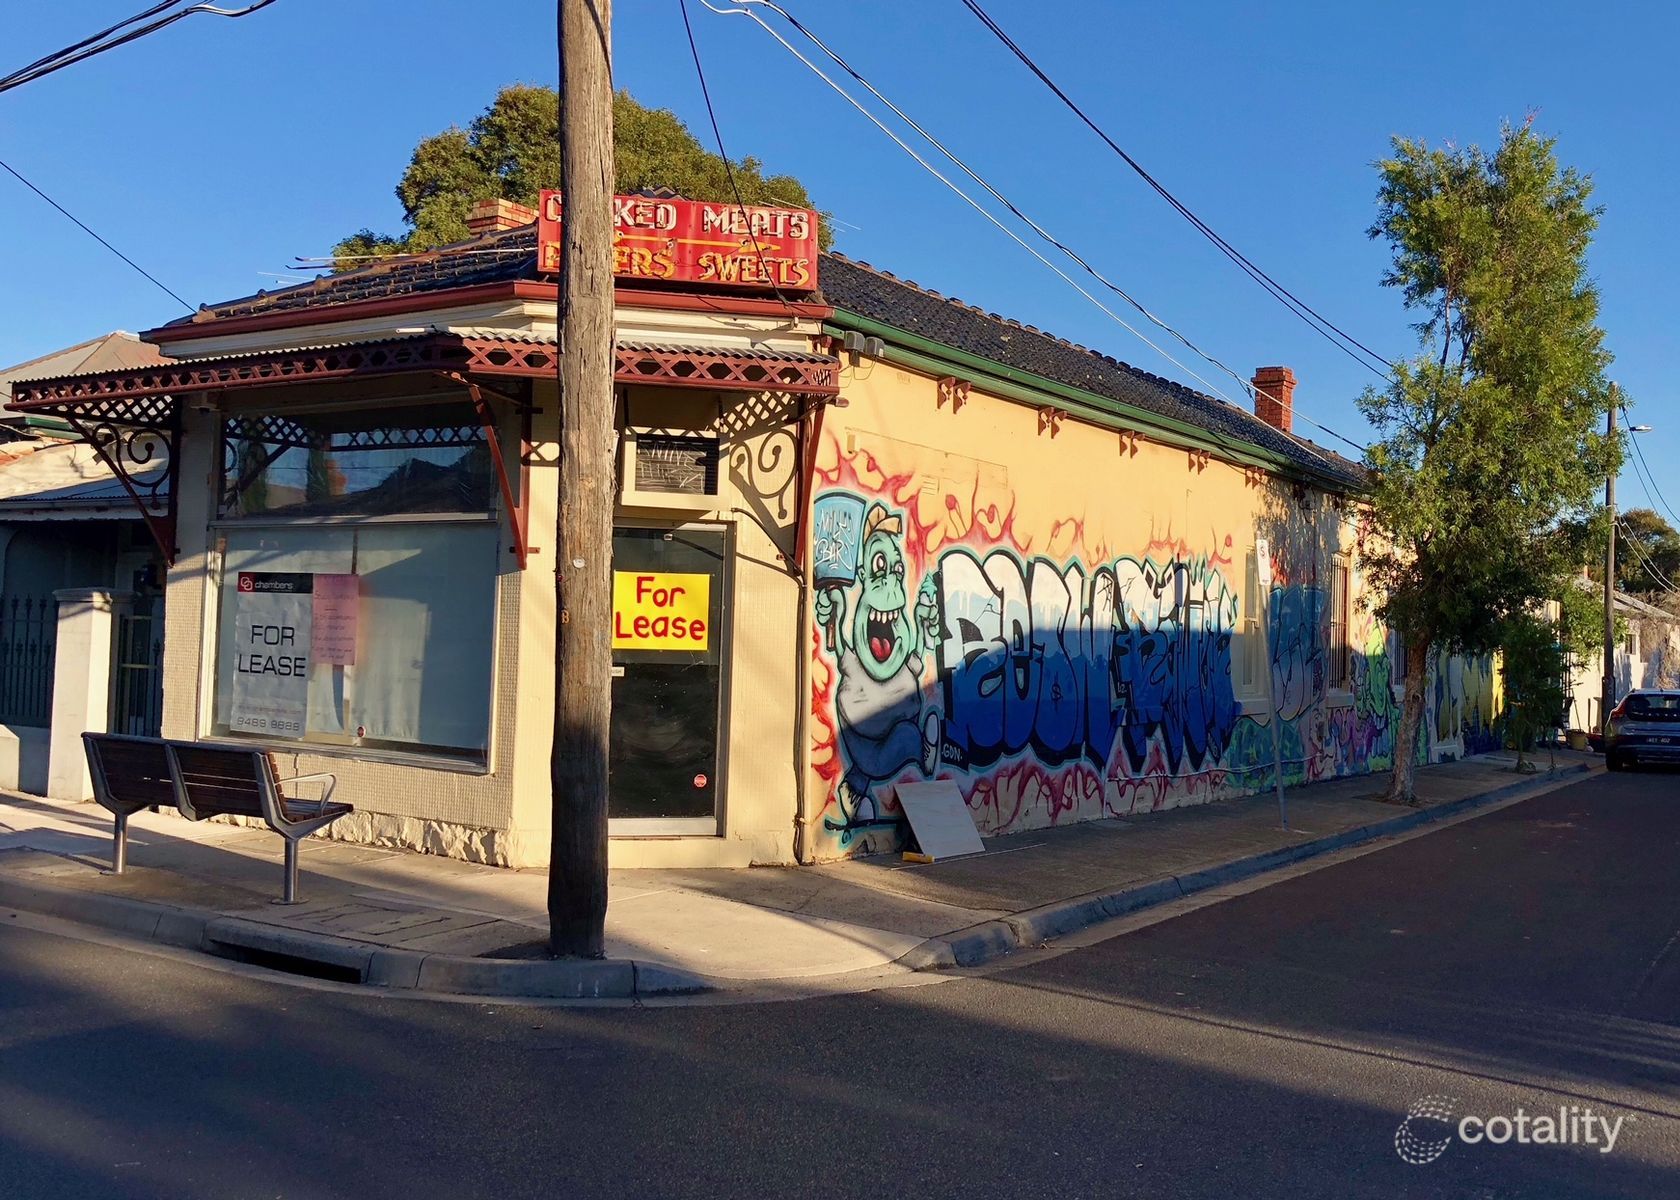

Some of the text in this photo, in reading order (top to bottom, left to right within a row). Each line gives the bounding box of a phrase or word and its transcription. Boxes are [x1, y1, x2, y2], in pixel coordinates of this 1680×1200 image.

[546, 194, 809, 239] CKED MEATS
[698, 252, 810, 286] SWEETS
[254, 580, 295, 590] chambers
[636, 576, 686, 607] For
[251, 625, 295, 646] FOR
[615, 611, 706, 641] Lease
[238, 654, 306, 677] LEASE
